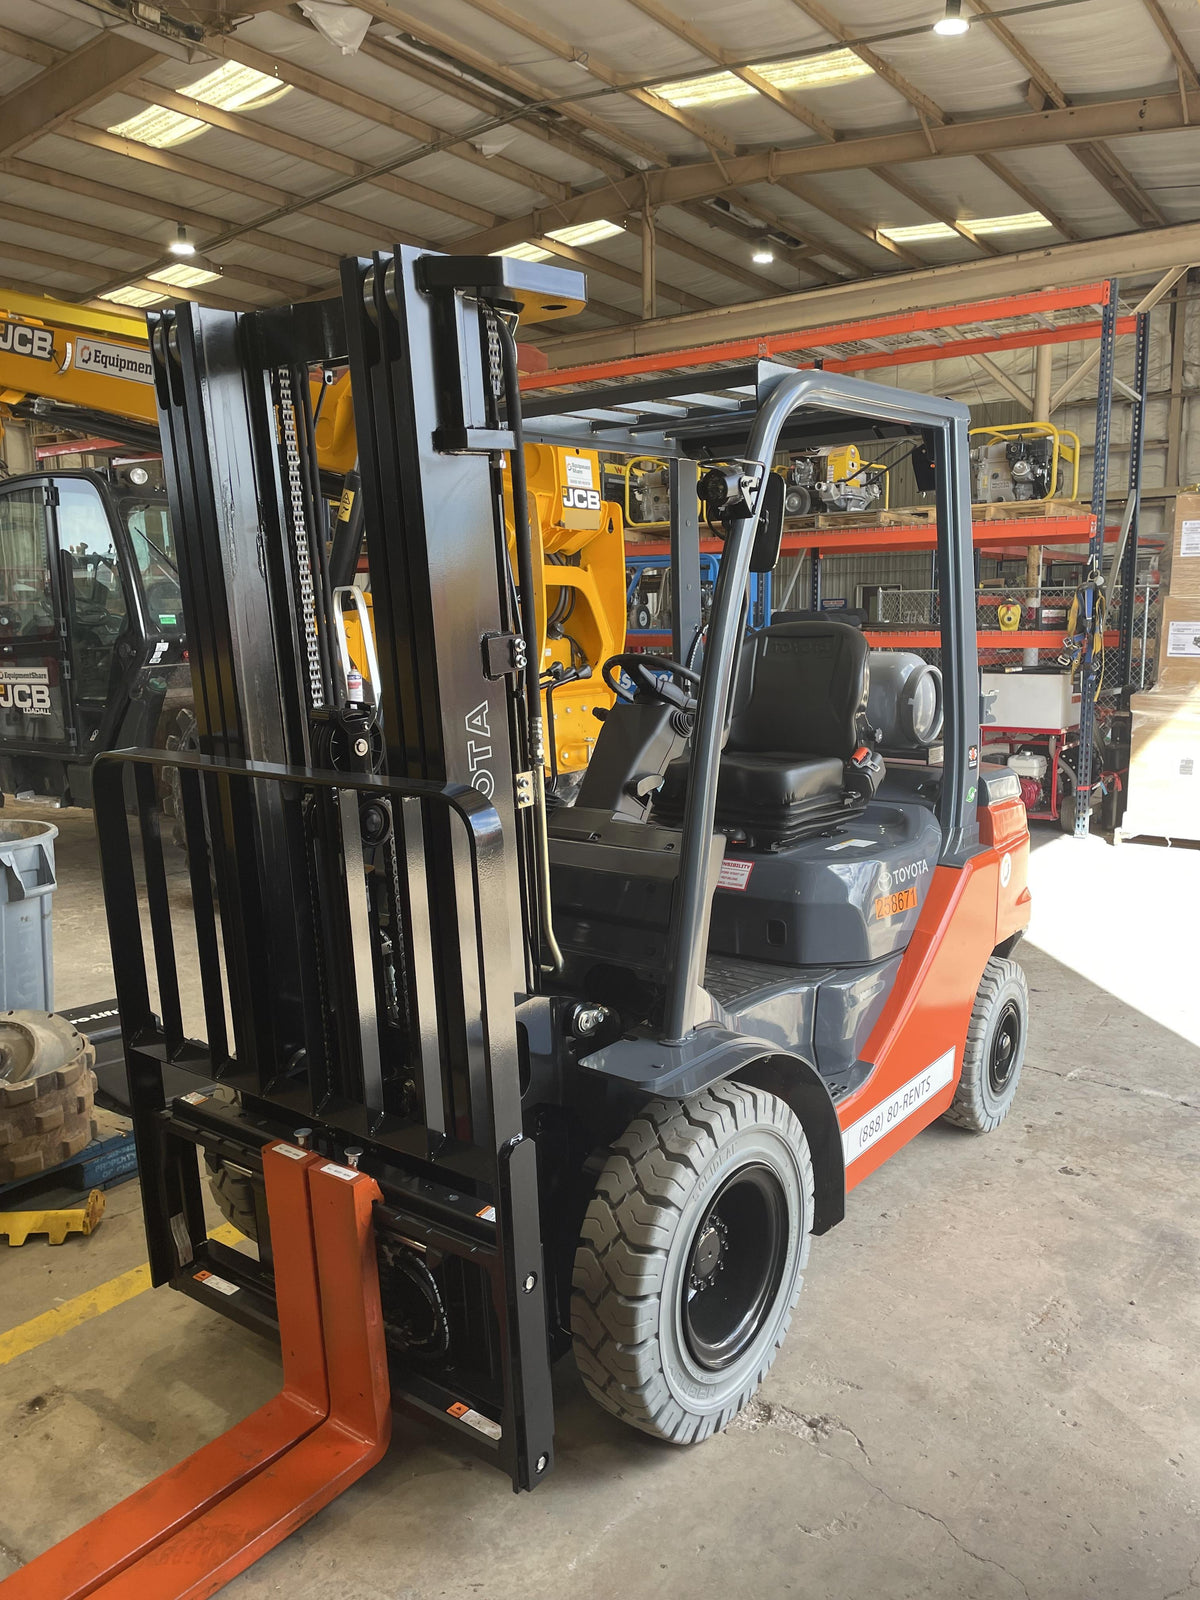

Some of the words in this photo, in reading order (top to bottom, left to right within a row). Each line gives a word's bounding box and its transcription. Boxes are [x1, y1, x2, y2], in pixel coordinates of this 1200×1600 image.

[0, 324, 53, 358] JCB
[563, 488, 601, 510] JCB
[4, 671, 47, 680] EquipmentShare
[0, 684, 51, 708] JCB
[23, 707, 52, 716] LOADALL
[892, 859, 929, 885] TOYOTA
[876, 889, 916, 918] 258671
[860, 1111, 884, 1148] (888)
[886, 1075, 931, 1123] 80-RENTS
